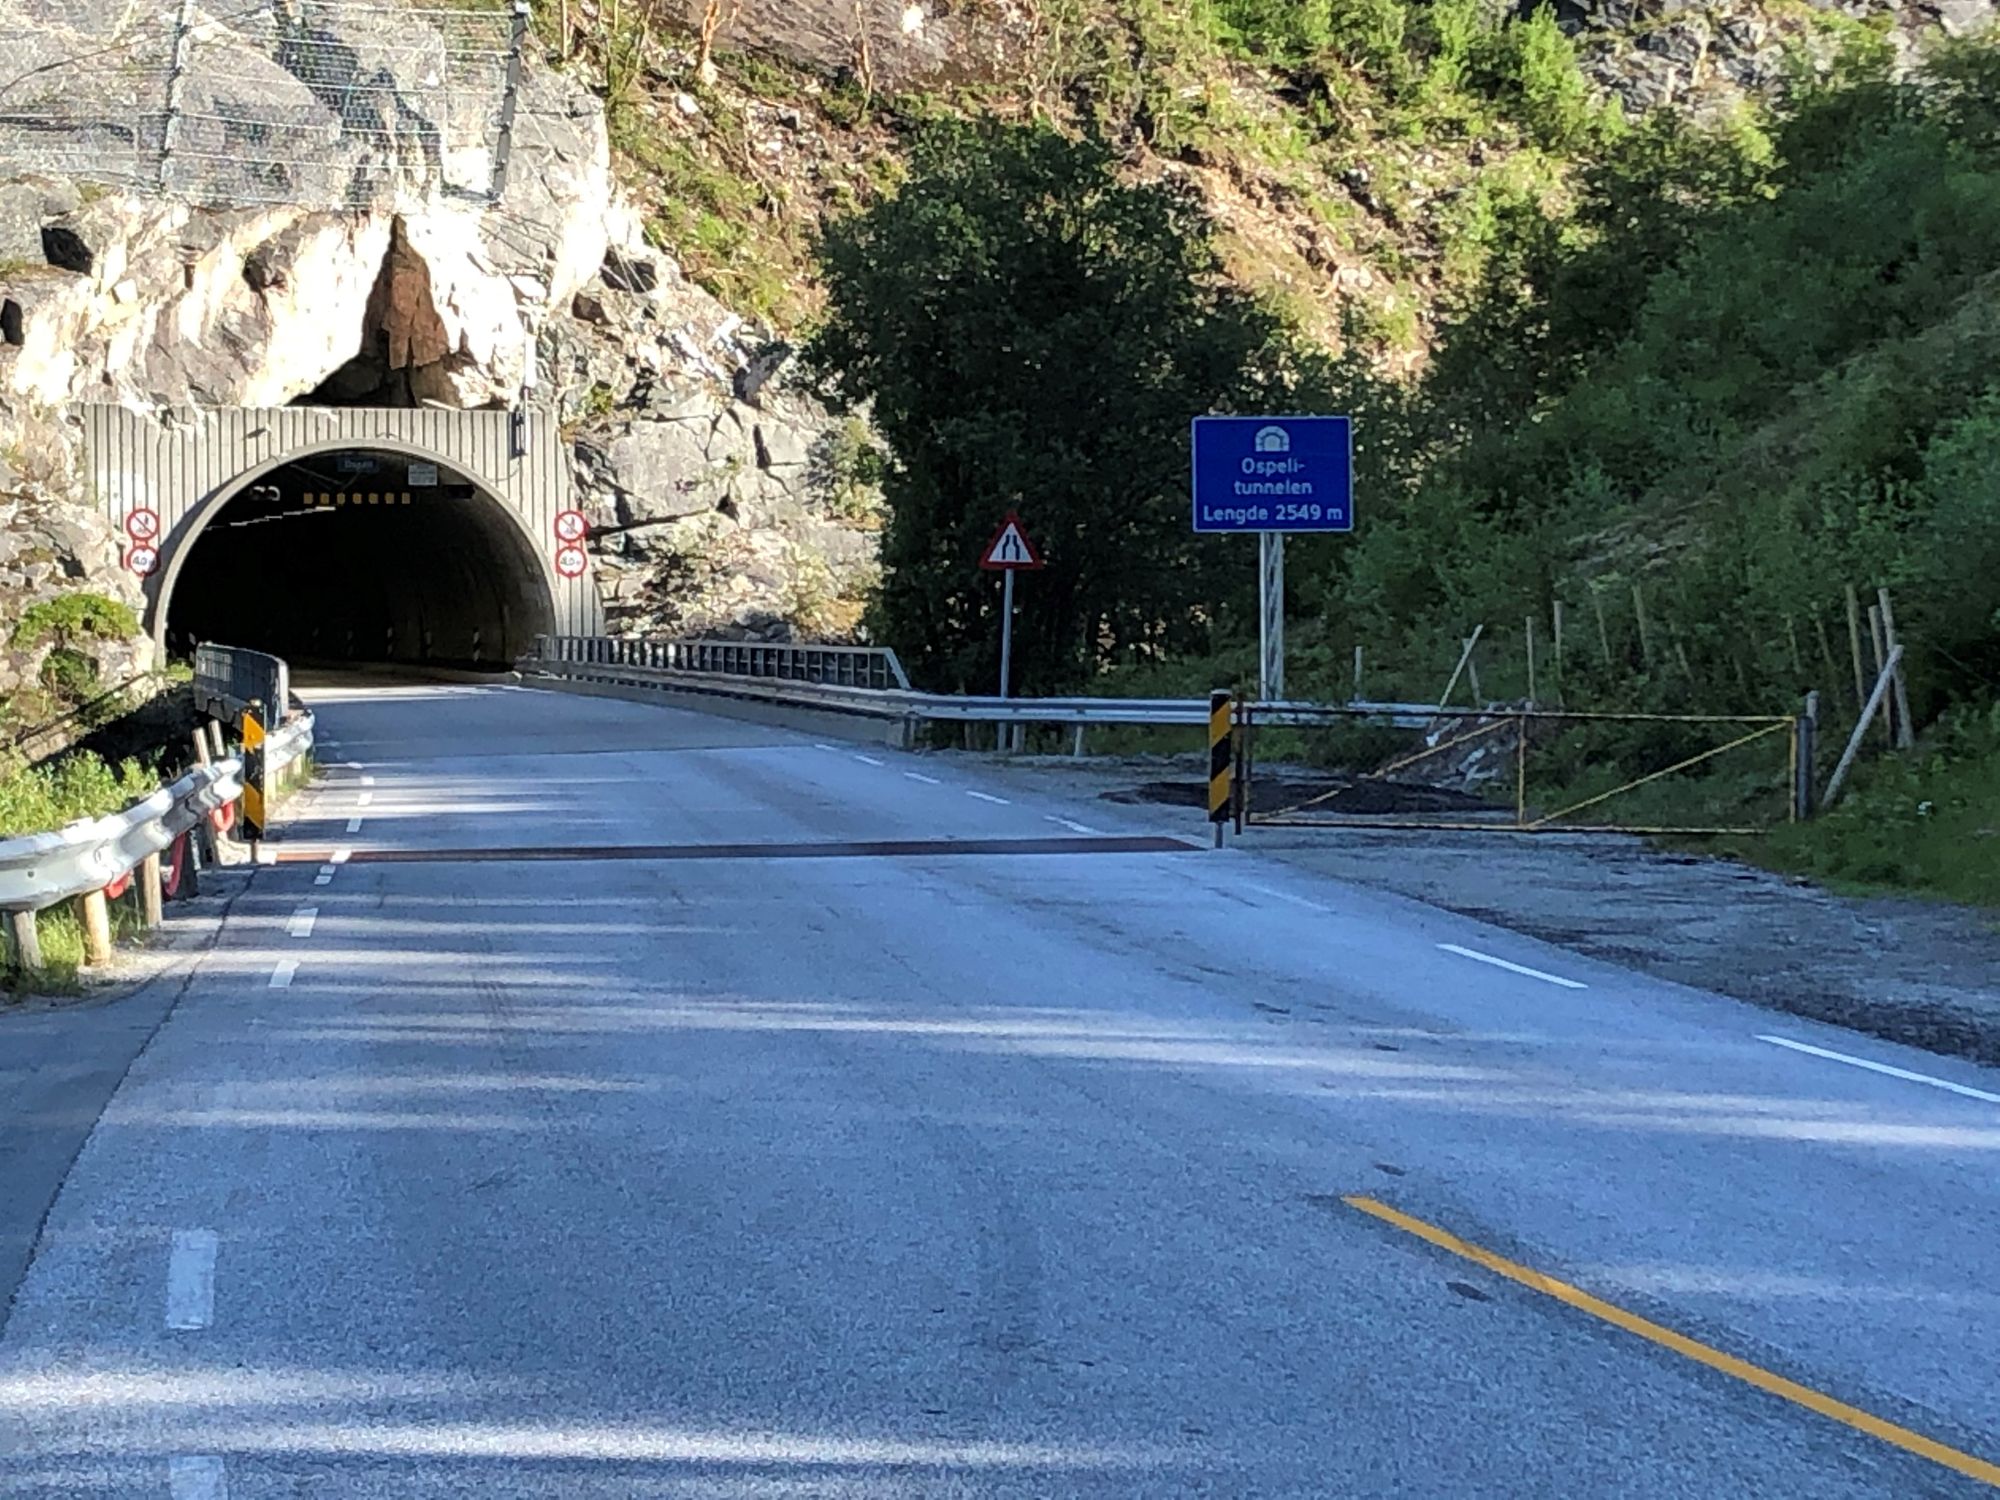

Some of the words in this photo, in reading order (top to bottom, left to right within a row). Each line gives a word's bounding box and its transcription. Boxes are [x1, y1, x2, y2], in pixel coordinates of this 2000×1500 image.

[1241, 457, 1305, 477] Ospeli-
[1234, 479, 1312, 495] tunnelen
[1203, 505, 1268, 525] Lengde
[1275, 504, 1321, 521] 2549
[1327, 507, 1343, 520] m
